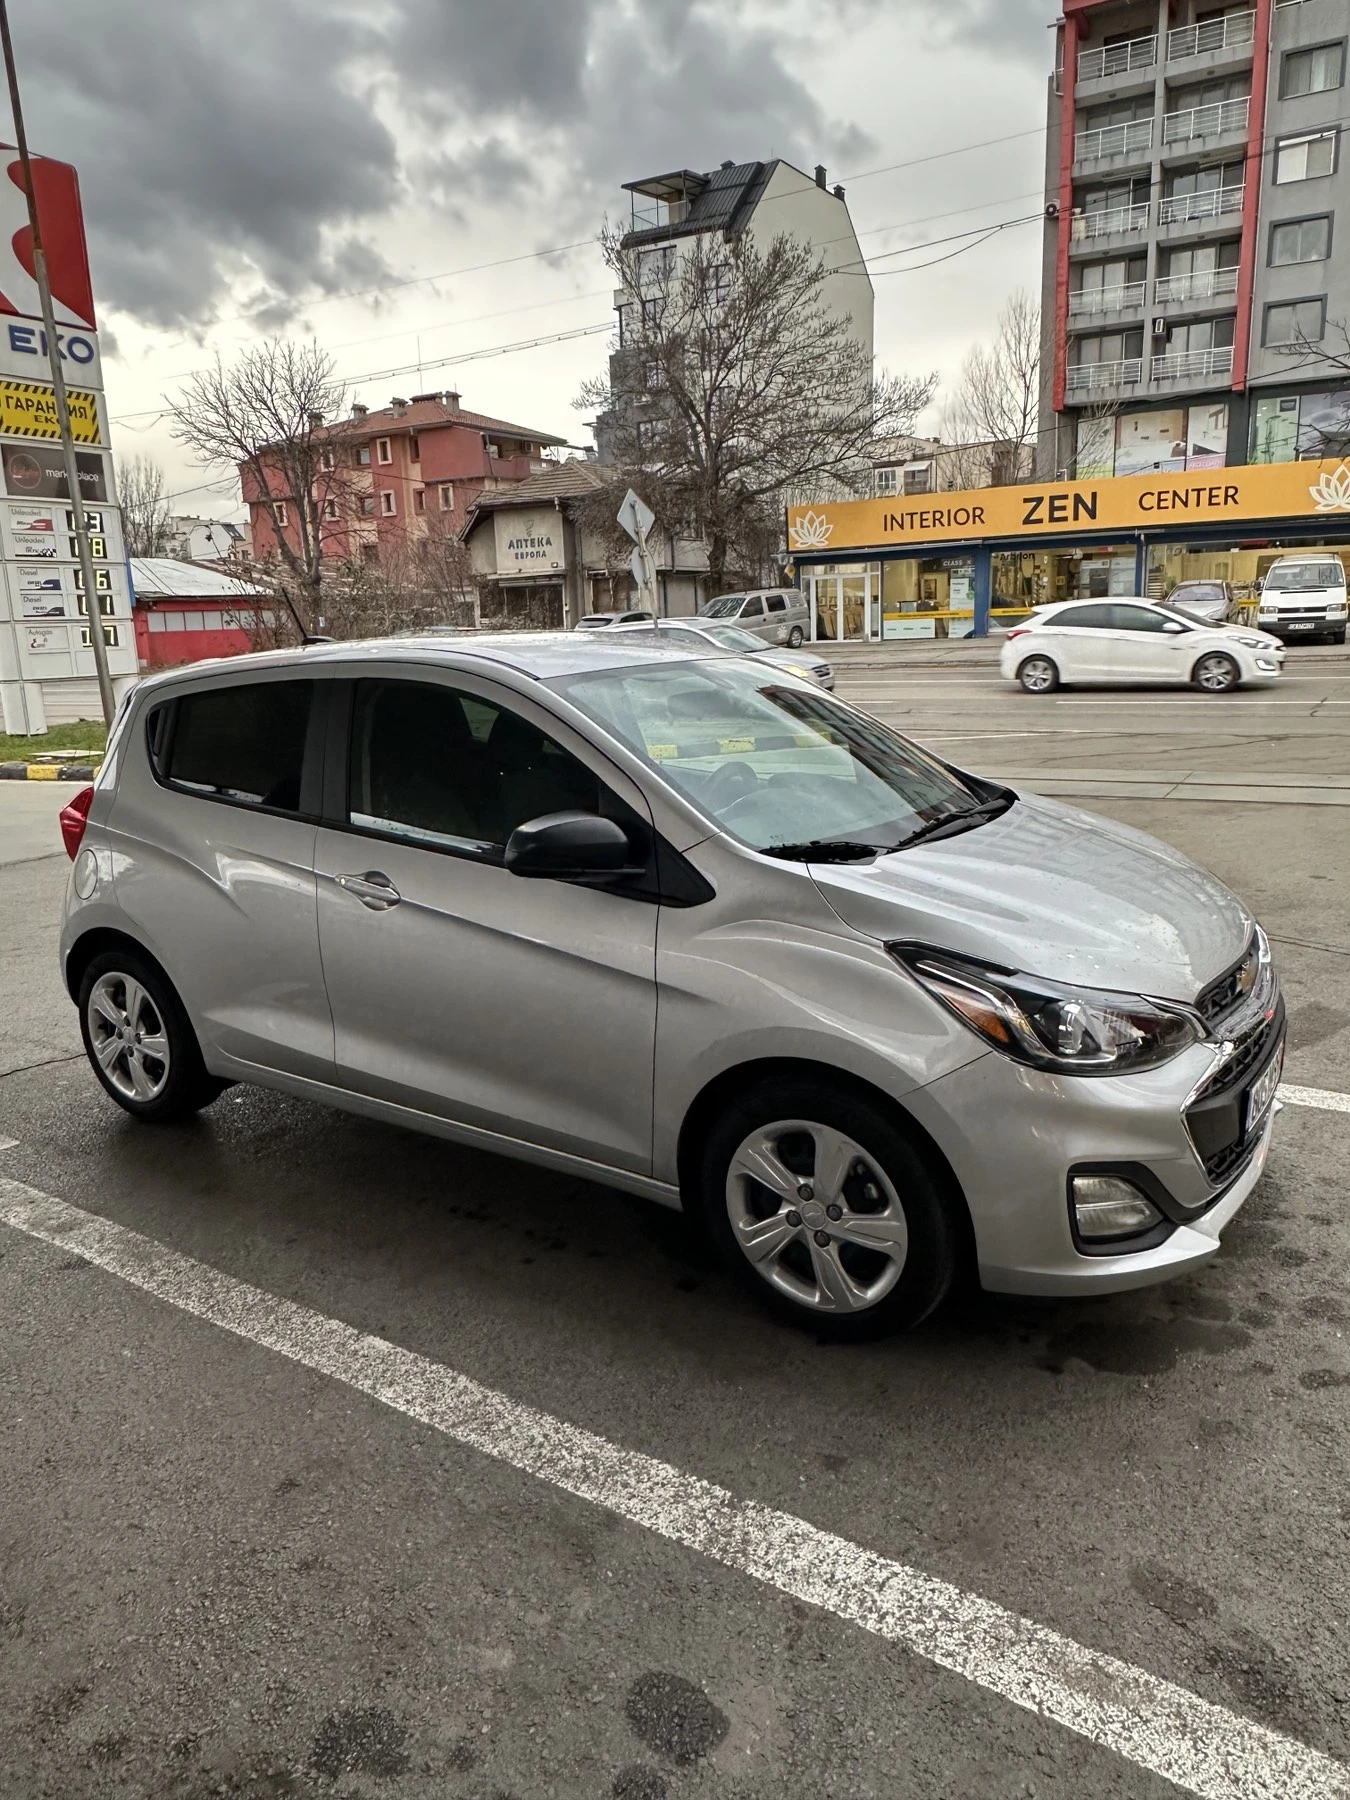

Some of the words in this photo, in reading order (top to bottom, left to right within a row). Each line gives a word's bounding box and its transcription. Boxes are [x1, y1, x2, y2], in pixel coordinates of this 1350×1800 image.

[8, 324, 95, 364] EKO
[5, 395, 88, 419] ГАРАНИЯ
[884, 506, 986, 532] INTERIOR
[1022, 491, 1098, 526] ZEN
[1138, 485, 1240, 512] CENTER
[508, 537, 553, 550] АПТЕКА
[514, 550, 547, 560] ЕВРОПА
